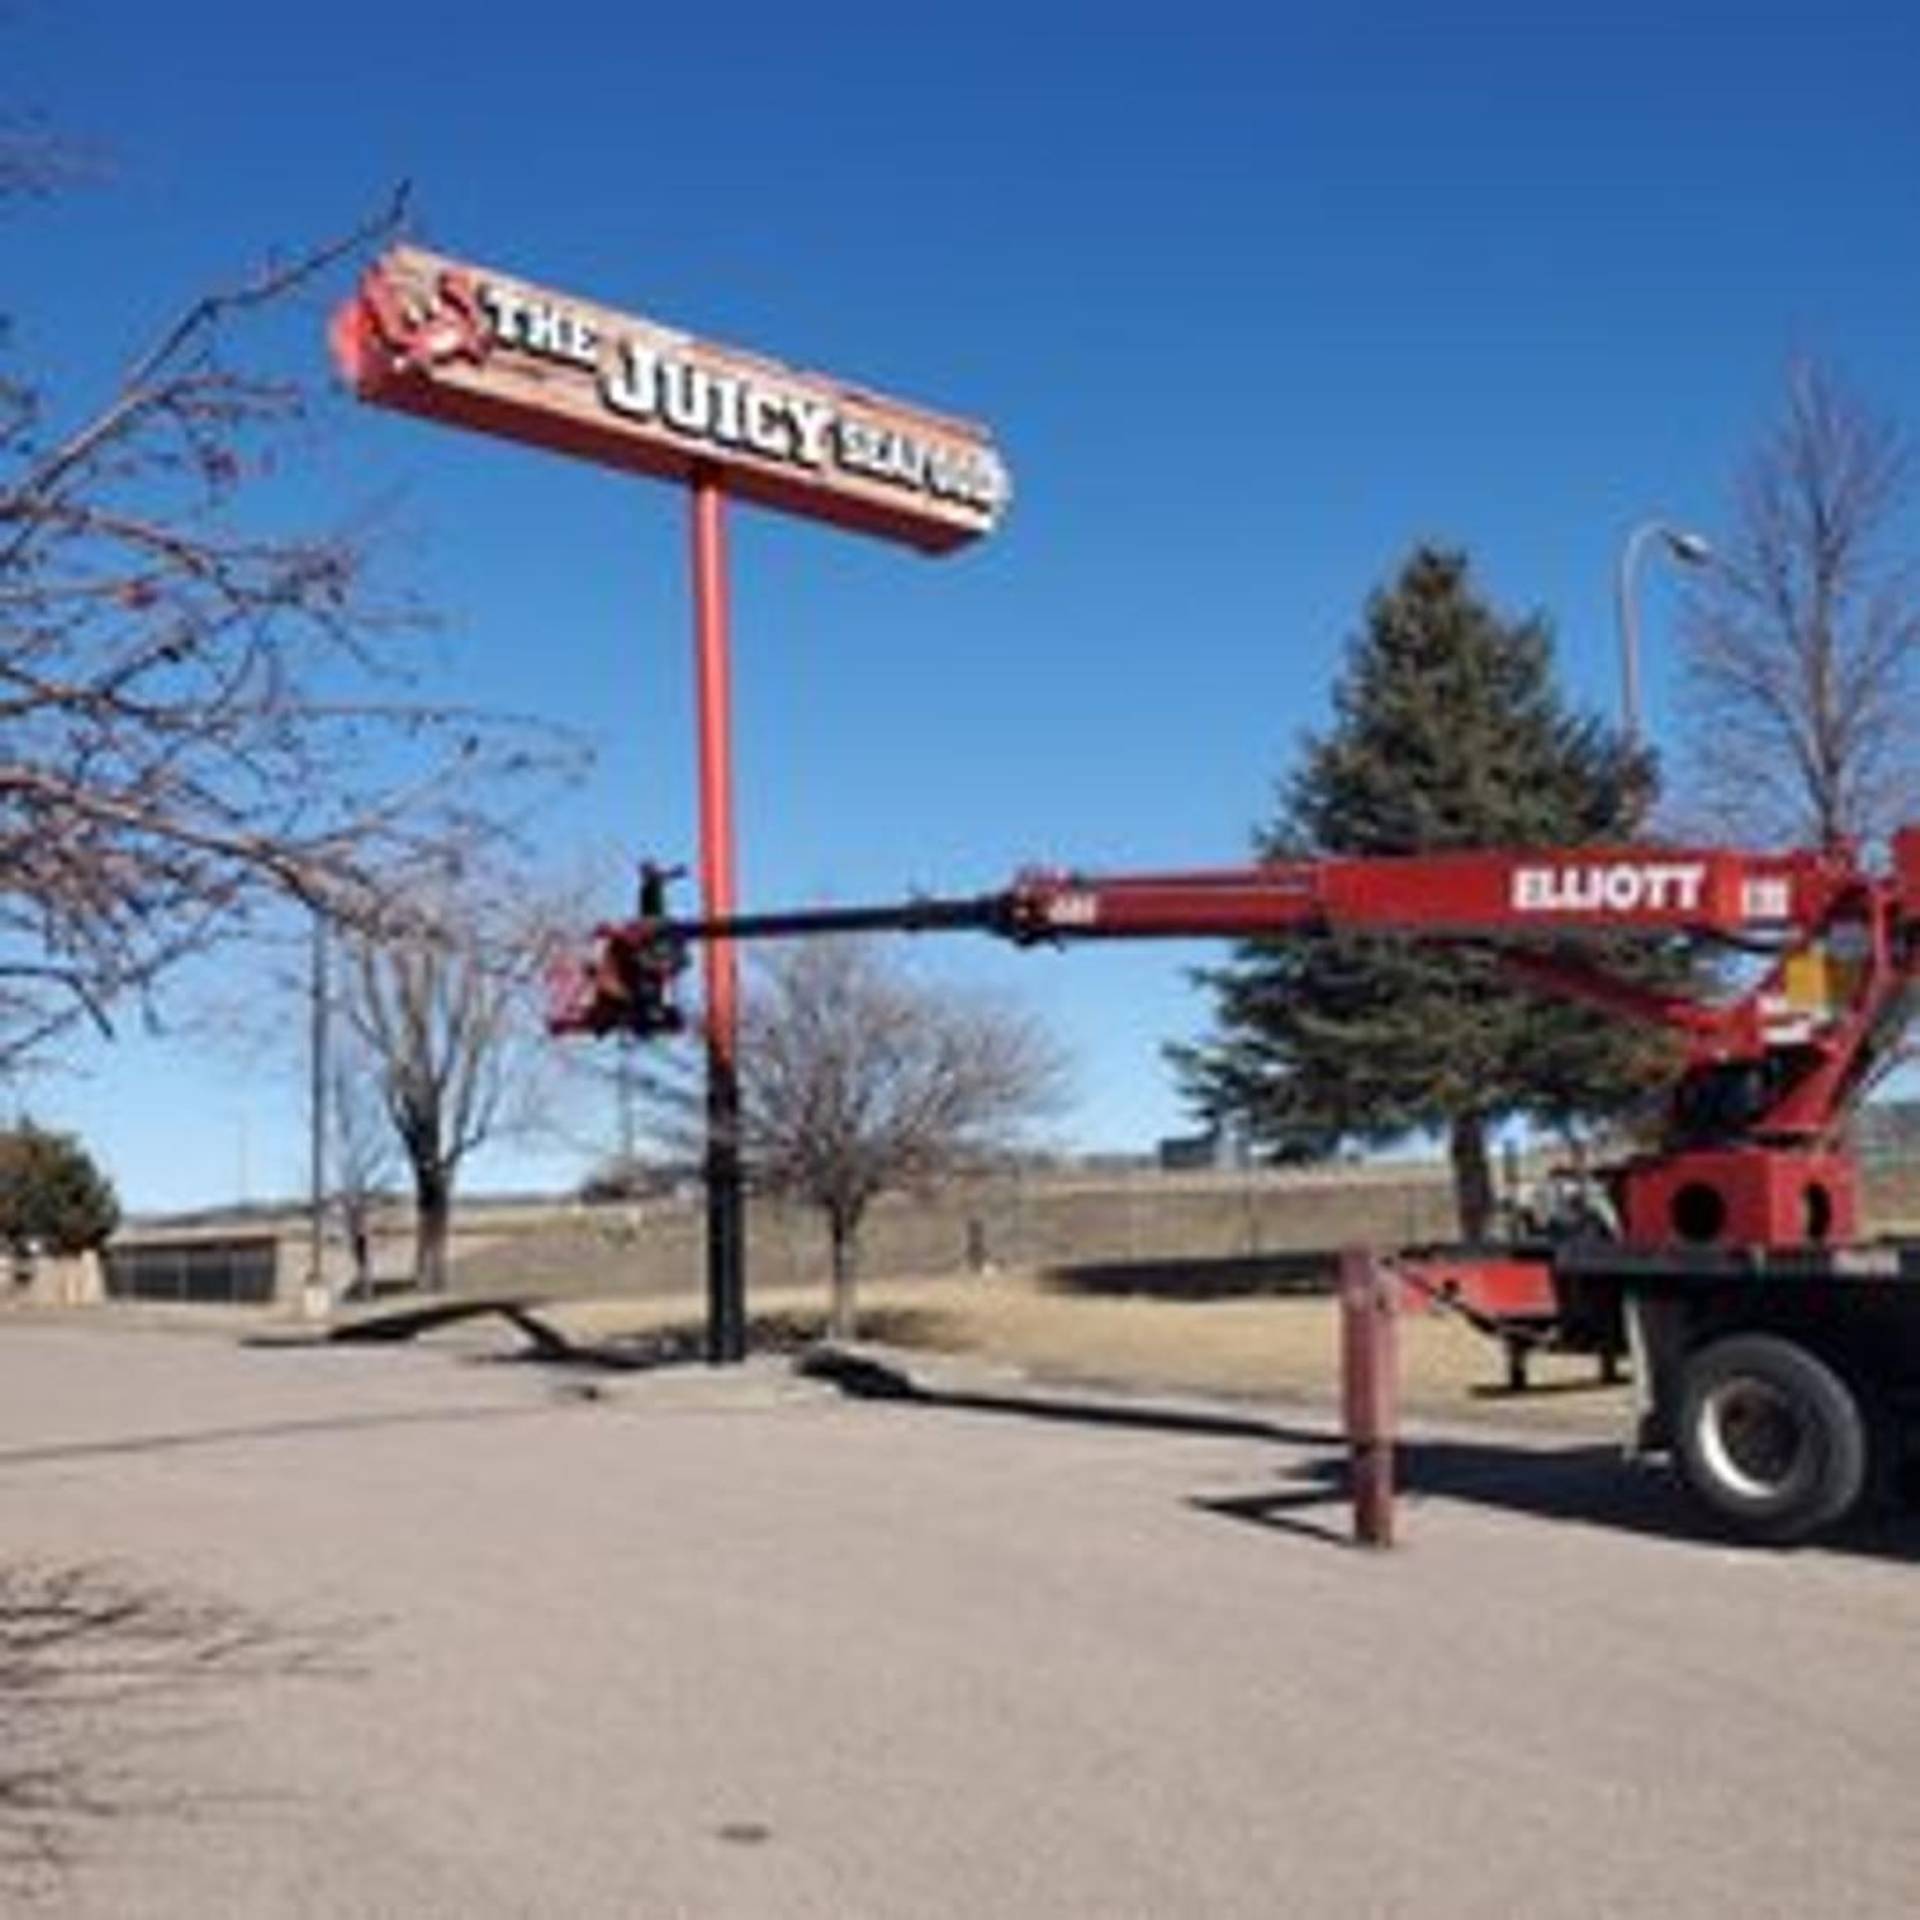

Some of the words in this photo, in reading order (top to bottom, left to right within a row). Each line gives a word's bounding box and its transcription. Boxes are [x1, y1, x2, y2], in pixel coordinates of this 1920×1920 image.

[487, 284, 602, 367] THE
[603, 340, 835, 467] JUICY
[1512, 863, 1705, 911] ELLIOTT
